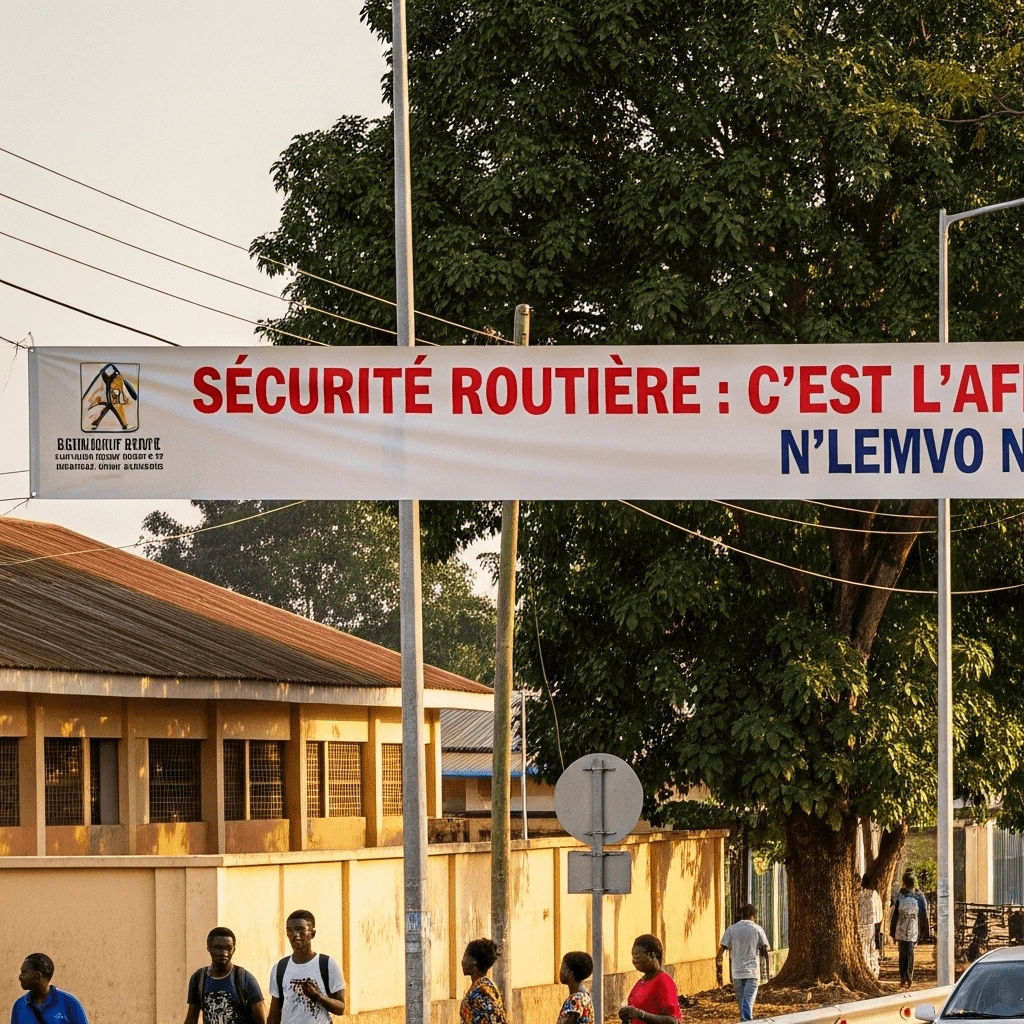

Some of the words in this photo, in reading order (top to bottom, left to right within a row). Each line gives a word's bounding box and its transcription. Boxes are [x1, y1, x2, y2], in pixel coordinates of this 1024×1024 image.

[193, 354, 433, 415] SÉCURITÉ
[452, 354, 701, 416] ROUTIÈRE
[719, 380, 729, 415] :
[748, 363, 892, 415] C’EST
[781, 427, 983, 475] N’LEMVO
